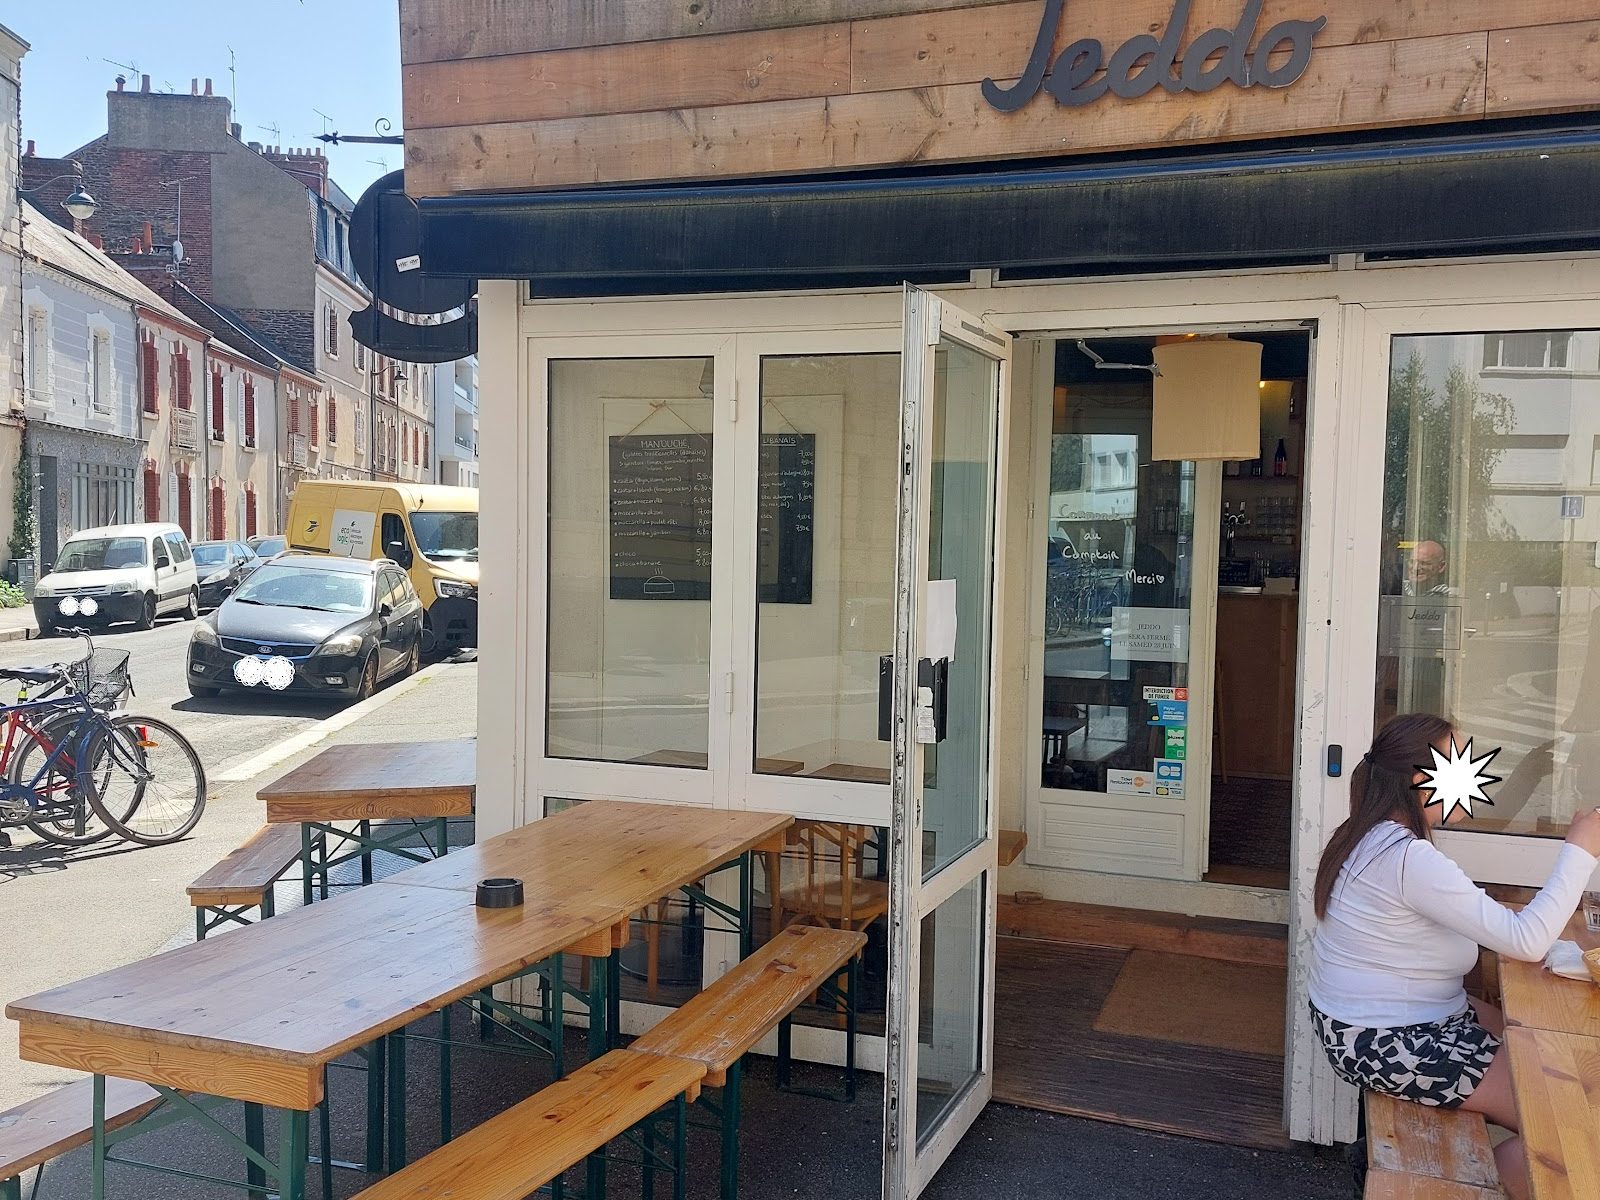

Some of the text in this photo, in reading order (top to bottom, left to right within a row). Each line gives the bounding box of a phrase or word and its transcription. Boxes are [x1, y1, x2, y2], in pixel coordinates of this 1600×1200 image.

[981, 0, 1328, 113] Jeddo
[1083, 532, 1102, 541] au
[1062, 546, 1120, 564] Comptoir
[1126, 568, 1156, 585] Merci
[1407, 608, 1441, 621] Jeddo
